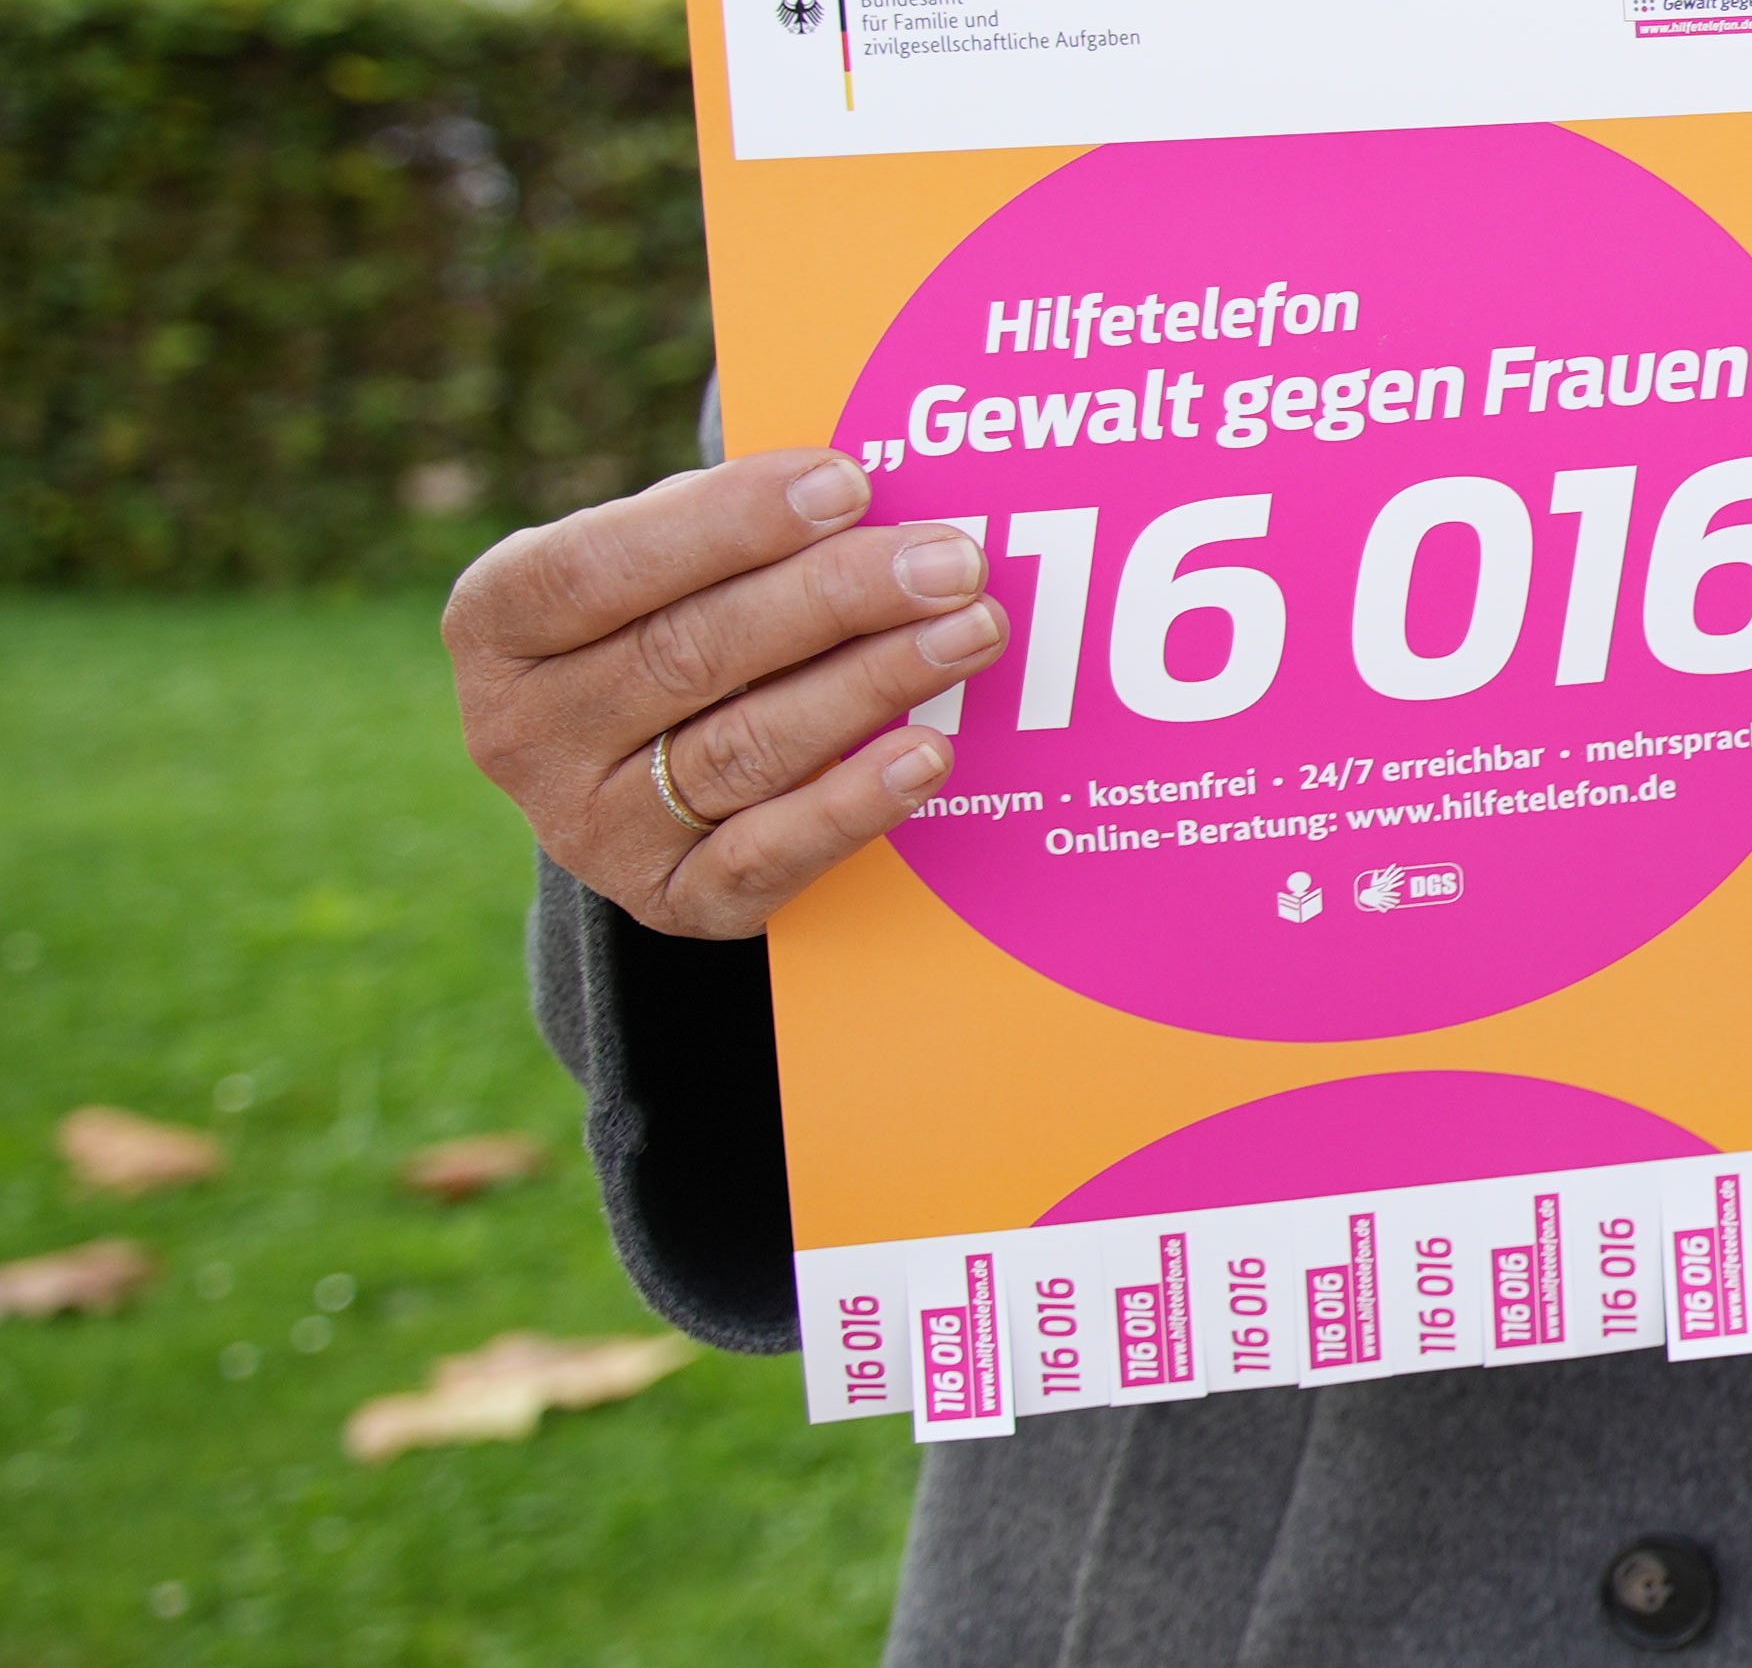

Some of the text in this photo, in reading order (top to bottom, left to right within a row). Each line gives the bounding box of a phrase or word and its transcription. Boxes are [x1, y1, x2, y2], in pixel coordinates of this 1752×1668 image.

[862, 10, 999, 32] für Familie und
[864, 29, 1141, 58] zivilgesellschaftliche Aufgaben
[985, 282, 1360, 359] Hilfetelefon
[861, 367, 1204, 473] „Gewalt
[1215, 363, 1465, 450] gegen
[1044, 774, 1677, 857] Online-Beratung: www.hilfetelefon.de
[1088, 769, 1257, 809] kostenfrei
[1298, 758, 1373, 794] 24/7
[1382, 743, 1545, 784] erreichbar
[1409, 871, 1457, 897] DGS
[1163, 1237, 1190, 1378] www.hilfetelefon.de
[1352, 1217, 1377, 1359] www.hilfetelefon.de
[1415, 1235, 1457, 1355] 116 016
[1498, 1250, 1533, 1343] 116 016
[1538, 1198, 1561, 1340] www.hilfetelefon.de
[1598, 1217, 1638, 1337] 116 016
[1680, 1234, 1716, 1334] 116 016
[1718, 1178, 1743, 1331] www.hilfetelefon.de
[838, 1295, 888, 1404] 116 016
[927, 1312, 966, 1415] 116 016
[969, 1258, 997, 1412] www.hilfetelefon.de
[1036, 1277, 1082, 1396] 116 016
[1121, 1290, 1160, 1382] 116 016
[1227, 1256, 1271, 1374] 116 016
[1312, 1270, 1348, 1363] 116 016
